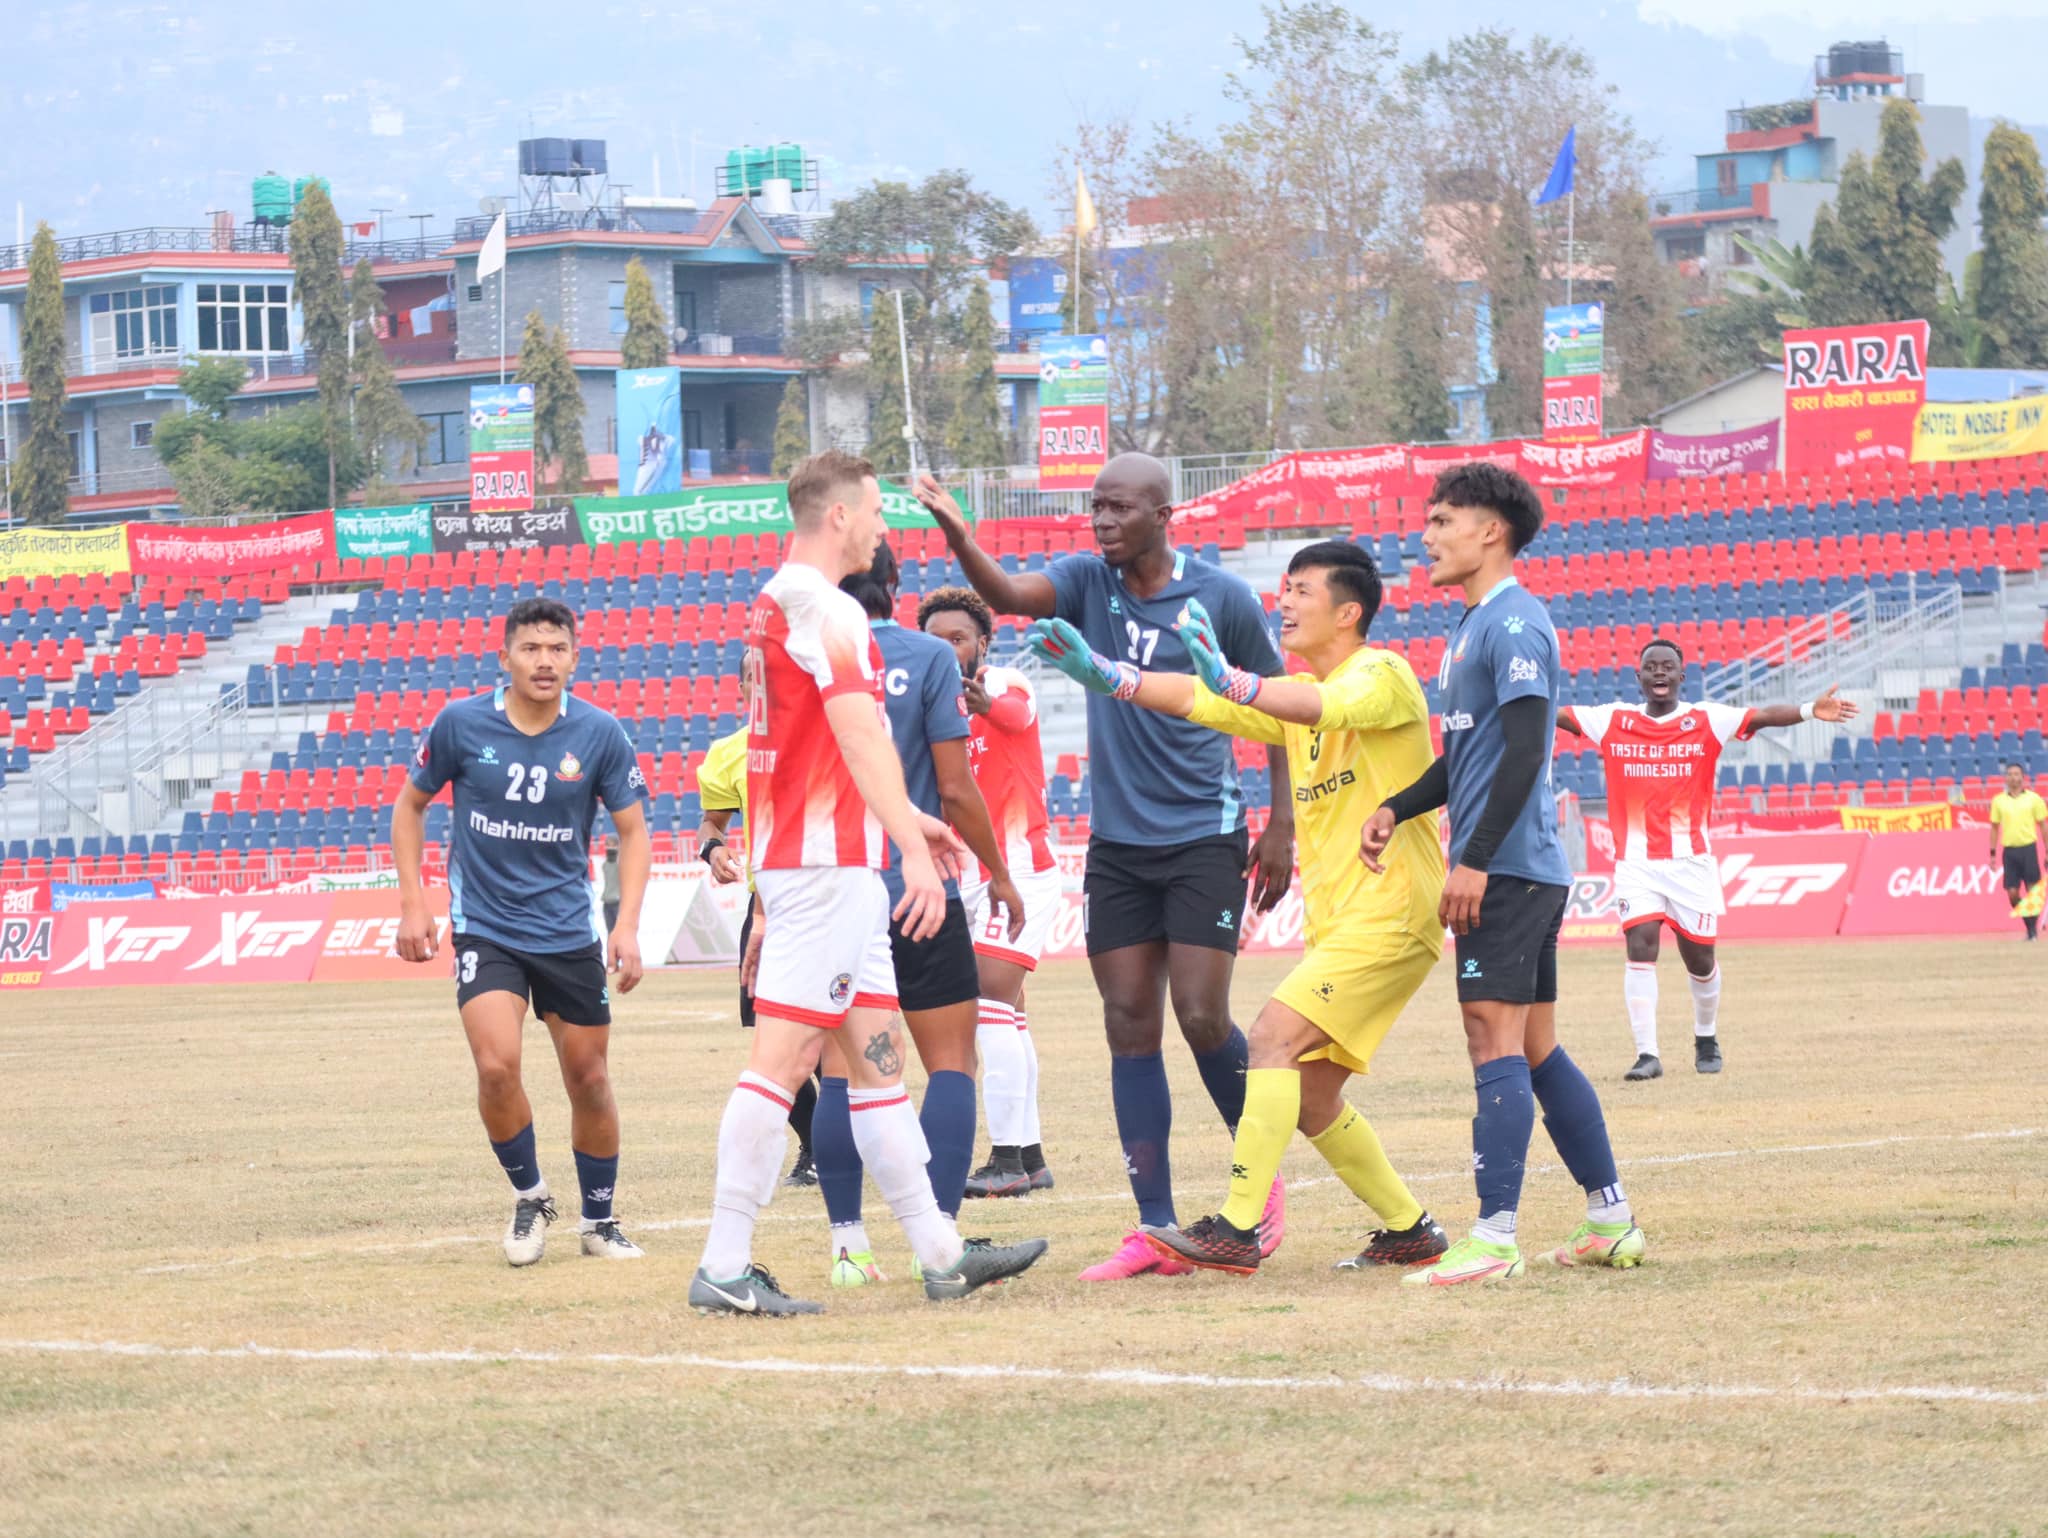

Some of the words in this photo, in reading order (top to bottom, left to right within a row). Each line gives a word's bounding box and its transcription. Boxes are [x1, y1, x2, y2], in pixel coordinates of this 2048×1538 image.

[1783, 335, 1924, 389] RARA
[1545, 395, 1600, 429] RARA
[1921, 411, 1957, 436] HOTEL
[1963, 410, 2009, 436] NOBLE
[1042, 425, 1104, 456] RARA
[1652, 437, 1697, 465] Smart
[1698, 442, 1731, 470] tyre
[1732, 434, 1769, 459] zone
[472, 470, 531, 500] RARA
[586, 510, 647, 544] कृपा
[1610, 743, 1646, 758] TASTE
[1649, 744, 1666, 758] OF
[1669, 743, 1706, 758] NEPAL
[505, 762, 549, 804] 23
[1623, 762, 1693, 778] MINNESOTA
[1887, 862, 2004, 898] GALAXY
[50, 916, 192, 975] XTEP
[183, 910, 323, 971] XTEP
